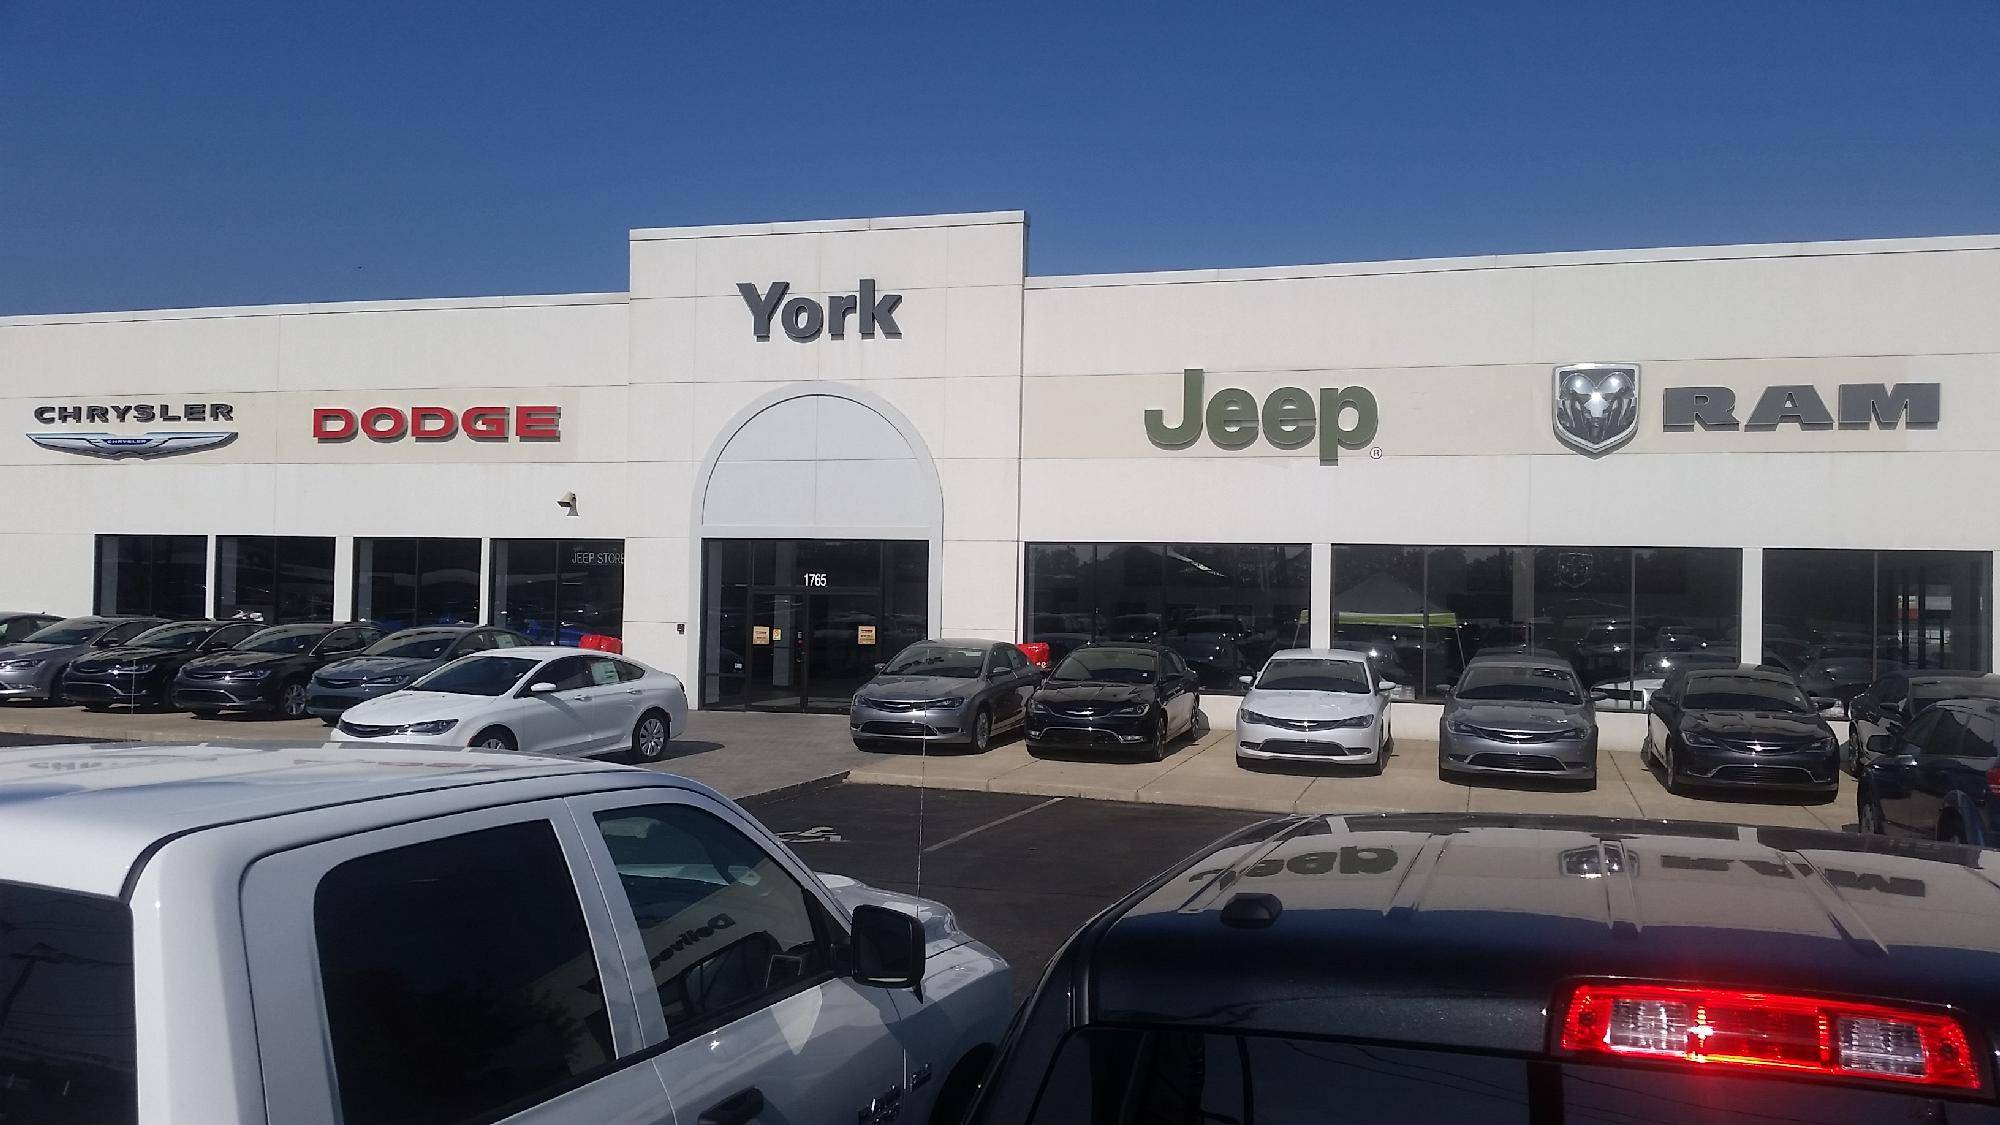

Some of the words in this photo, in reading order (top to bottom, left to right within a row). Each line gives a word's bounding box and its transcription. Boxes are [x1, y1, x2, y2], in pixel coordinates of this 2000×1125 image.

[736, 279, 903, 343] York
[33, 403, 235, 425] CHRYSLER
[313, 406, 562, 443] DODGE
[1144, 368, 1379, 466] Jeep
[1662, 382, 1941, 433] RAM
[571, 552, 595, 564] JEEP
[803, 572, 828, 587] 1765
